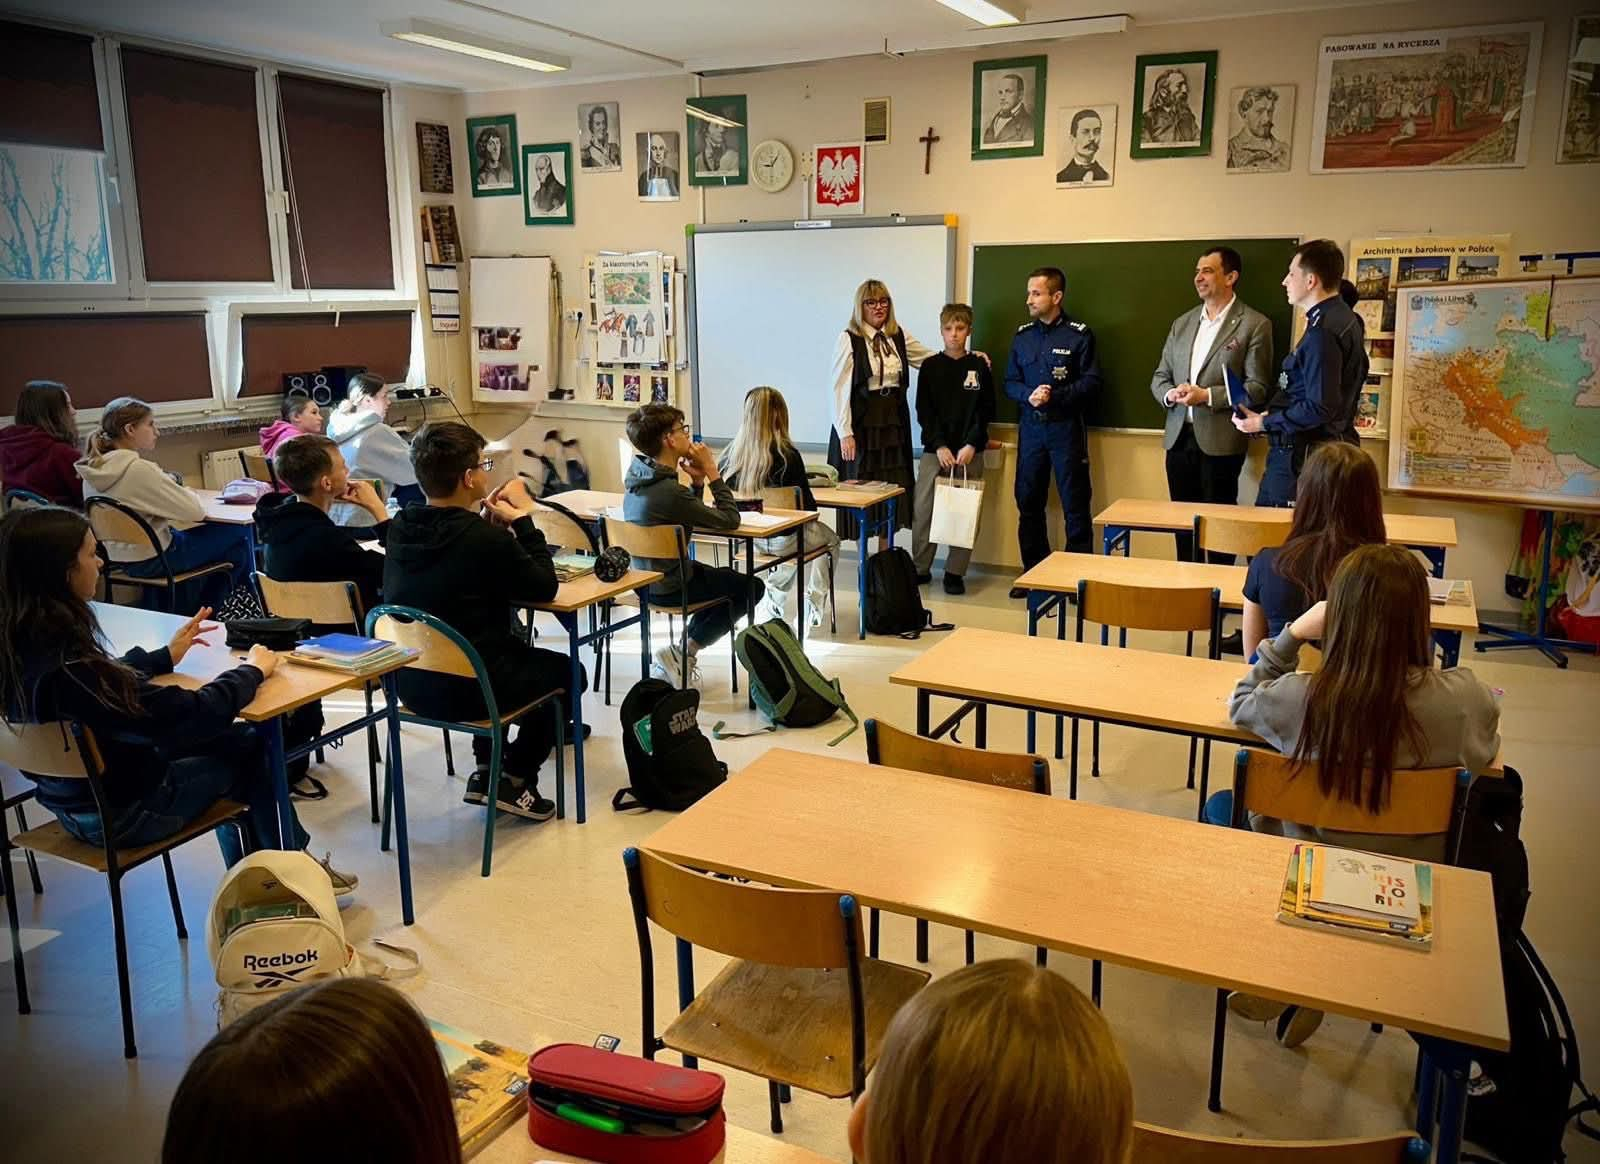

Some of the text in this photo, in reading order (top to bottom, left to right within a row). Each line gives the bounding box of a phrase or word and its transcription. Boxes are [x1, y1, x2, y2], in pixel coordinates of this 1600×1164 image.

[1325, 42, 1377, 53] PASOWANIE
[1397, 39, 1440, 49] RYCERZA
[1363, 245, 1412, 256] Architektura
[1415, 245, 1456, 254] barokowa
[1468, 244, 1495, 253] Polsce
[243, 949, 318, 971] Reebok
